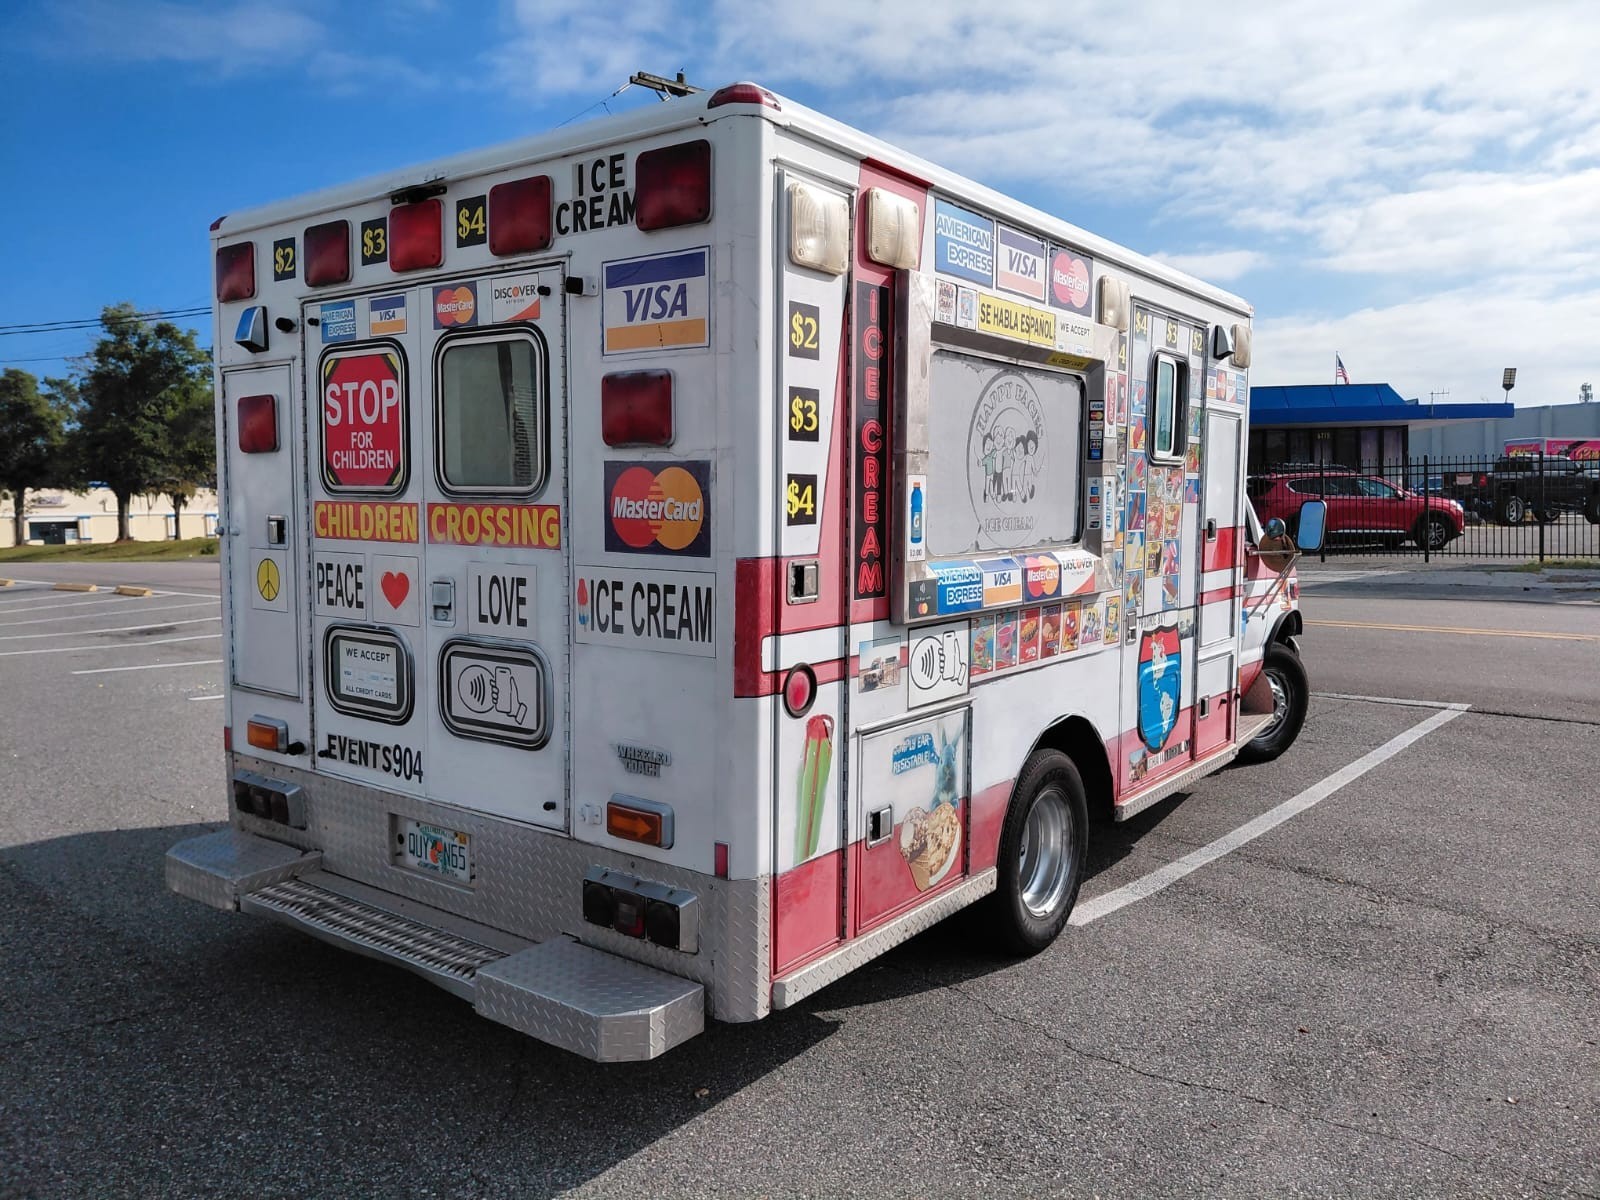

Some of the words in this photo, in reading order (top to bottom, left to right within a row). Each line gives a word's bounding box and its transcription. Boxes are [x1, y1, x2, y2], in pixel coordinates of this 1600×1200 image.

[577, 153, 626, 197] ICE
[457, 205, 486, 240] $4
[935, 212, 991, 251] AMERICAN
[363, 227, 386, 258] $3
[274, 246, 295, 276] $2
[947, 241, 993, 276] EXPRESS
[1007, 249, 1038, 279] VISA
[494, 285, 536, 299] DISCOVER
[1053, 268, 1090, 292] MasterCard
[321, 308, 353, 321] AMERICAN
[379, 311, 396, 321] VISA
[436, 301, 474, 313] MasterCard
[622, 282, 689, 323] VISA
[980, 302, 992, 325] SE
[993, 305, 1019, 332] HABLA
[328, 322, 356, 336] EXPRESS
[791, 311, 818, 349] $2
[1060, 322, 1070, 333] WE
[1070, 324, 1091, 337] ACCEPT
[1135, 311, 1147, 334] $4
[1166, 322, 1177, 344] $3
[863, 288, 883, 400] ICE
[1193, 330, 1203, 352] $2
[325, 379, 399, 426] STOP
[791, 395, 818, 432] $3
[976, 381, 1013, 437] HAPPY
[351, 431, 373, 449] FOR
[332, 449, 394, 470] CHILDREN
[612, 496, 701, 522] MasterCard
[787, 479, 814, 518] $4
[858, 419, 883, 594] CREAM
[315, 504, 418, 541] CHILDREN
[431, 506, 560, 547] CROSSING
[985, 517, 1001, 533] ICE
[936, 566, 982, 585] AMERICAN
[1028, 568, 1058, 583] MasterCard
[1063, 557, 1093, 570] DISCOVER
[993, 572, 1012, 586] VISA
[316, 562, 365, 609] PEACE
[477, 575, 528, 628] LOVE
[947, 585, 982, 605] EXPRESS
[590, 578, 624, 635] ICE
[630, 581, 713, 643] CREAM
[345, 647, 358, 658] WE
[360, 650, 391, 664] ACCEPT
[327, 734, 424, 784] EVENTS904
[408, 832, 429, 860] QUY
[443, 842, 466, 871] N65
